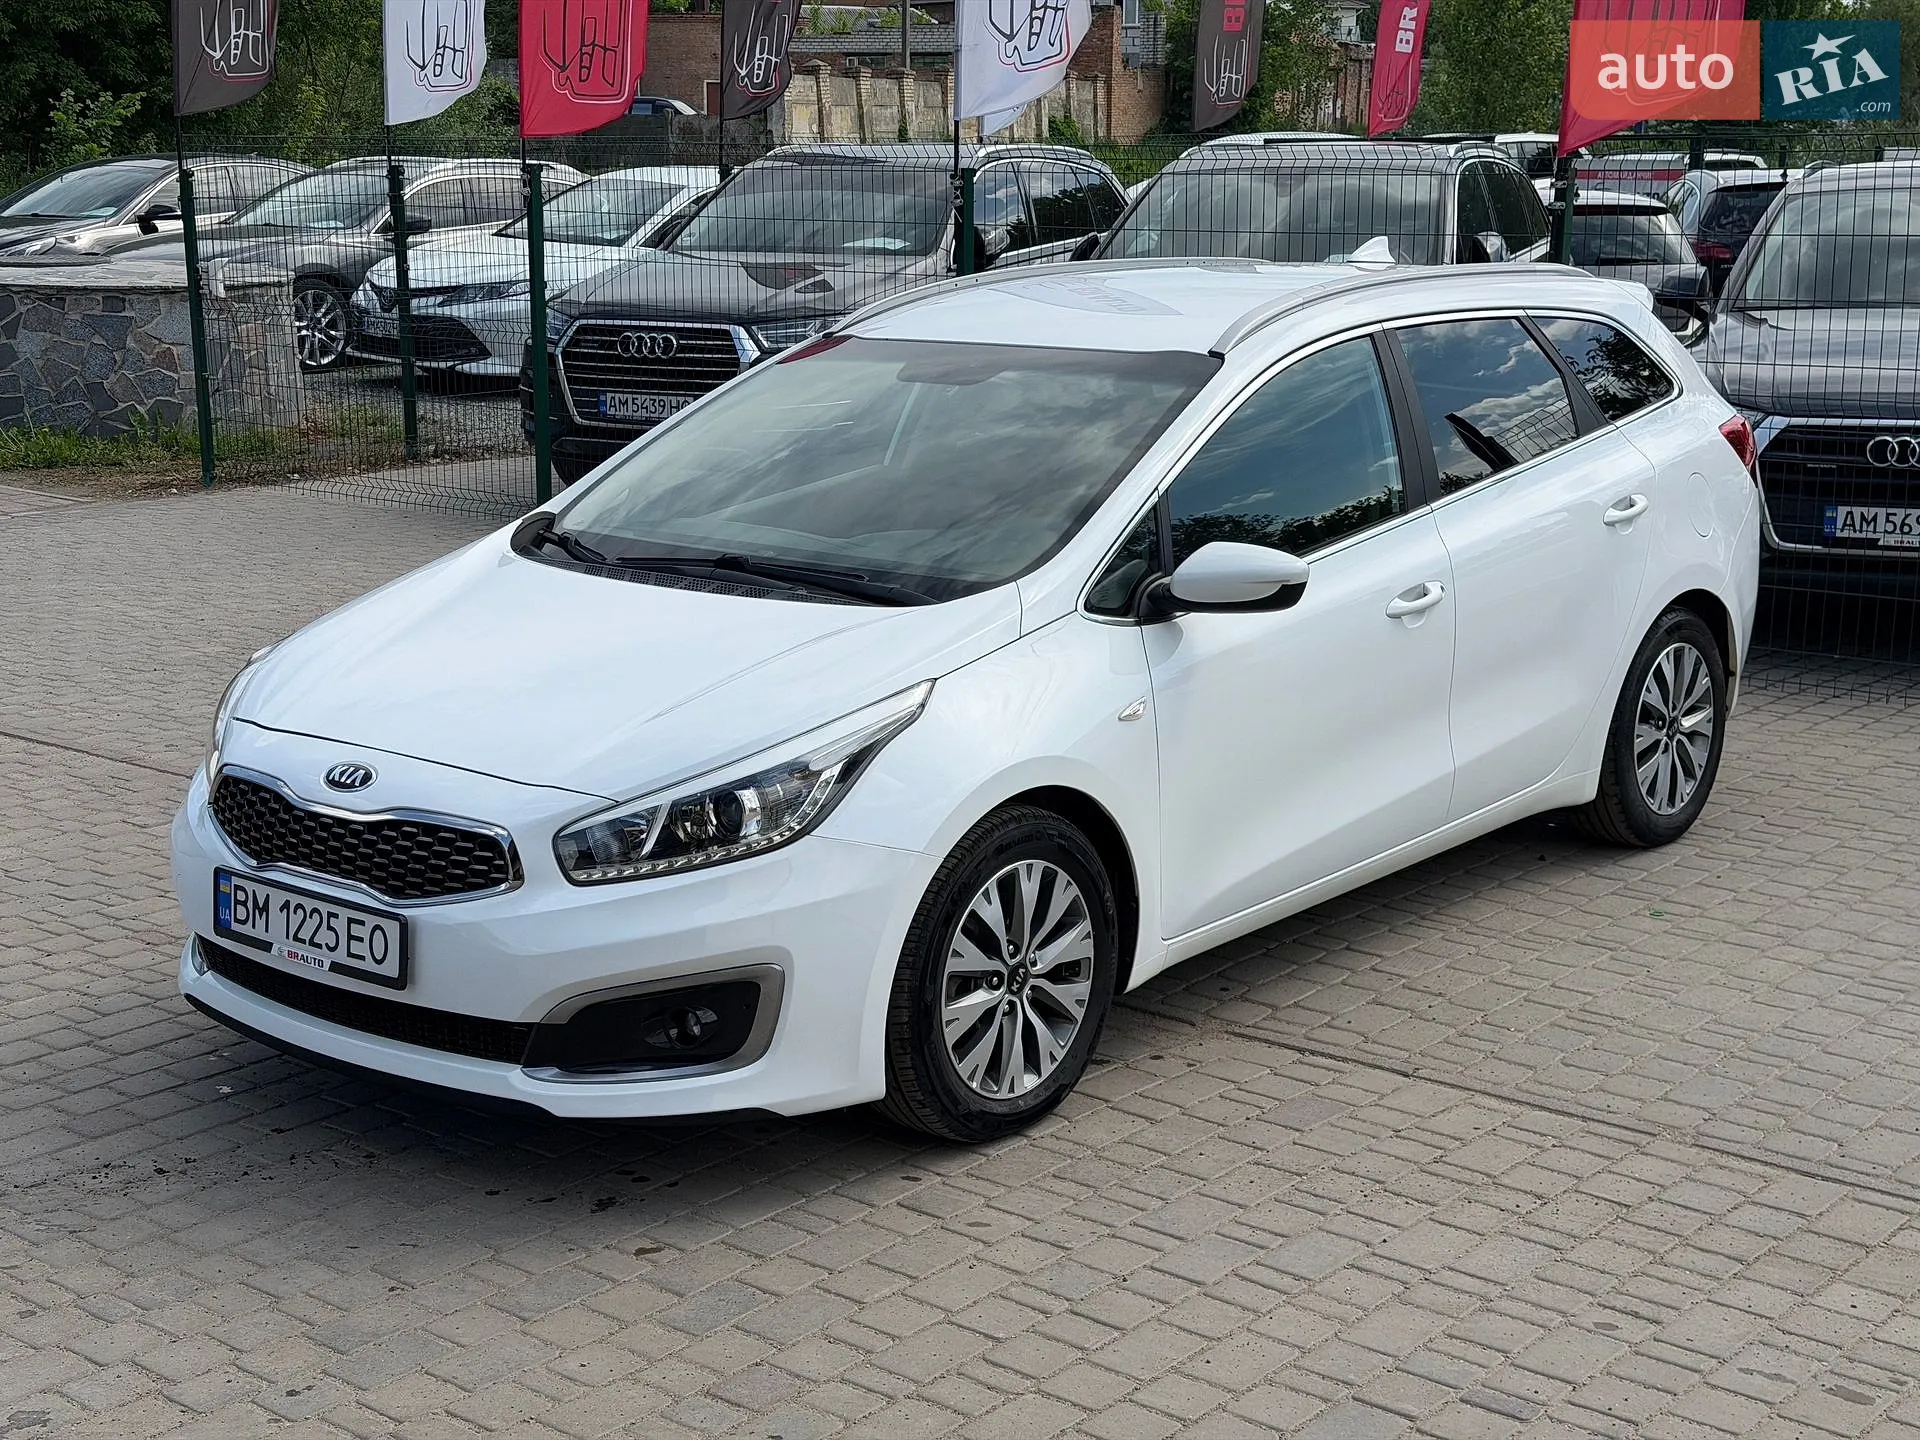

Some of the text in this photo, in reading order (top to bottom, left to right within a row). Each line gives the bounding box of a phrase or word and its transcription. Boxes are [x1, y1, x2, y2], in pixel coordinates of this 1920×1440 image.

[1395, 4, 1418, 53] BR
[608, 396, 629, 414] AM
[632, 398, 666, 415] 5439
[1840, 511, 1879, 534] AM
[329, 765, 366, 787] KIA
[219, 908, 231, 922] UA
[233, 883, 389, 965] BM 1225 EO
[287, 950, 324, 969] BRAUTO
[1011, 968, 1026, 992] KIA
